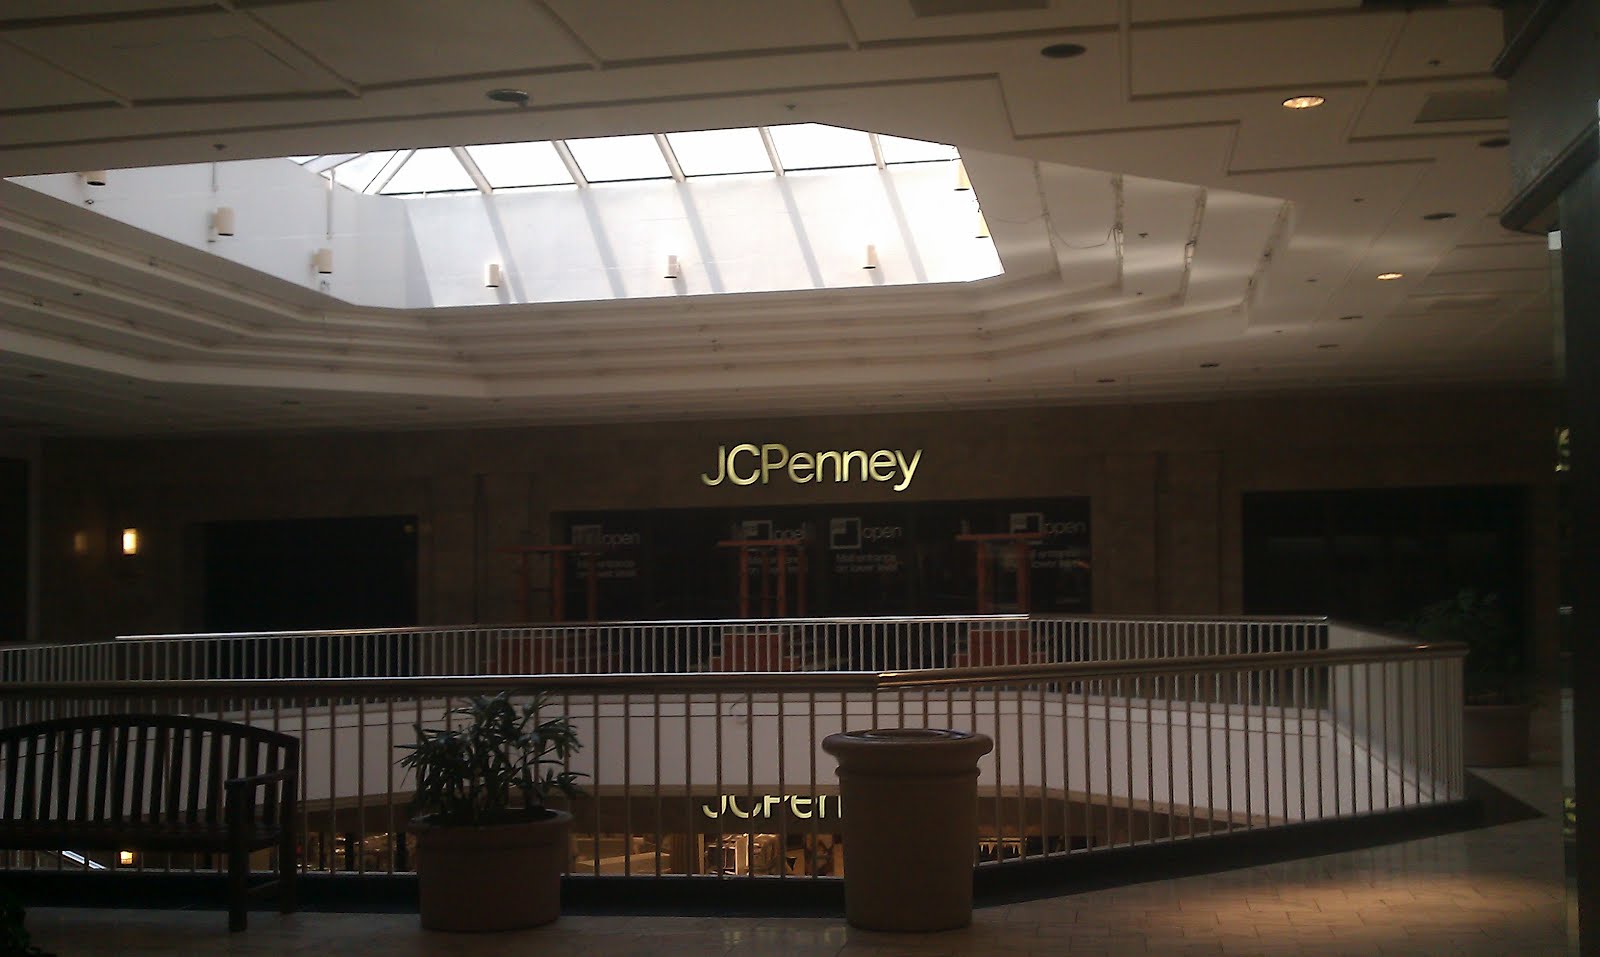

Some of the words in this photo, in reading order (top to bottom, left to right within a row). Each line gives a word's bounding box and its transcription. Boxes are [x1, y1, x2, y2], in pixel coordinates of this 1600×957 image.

[701, 442, 923, 492] JCPenney
[602, 532, 641, 550] open
[863, 525, 903, 544] open
[702, 793, 844, 819] JCPen
